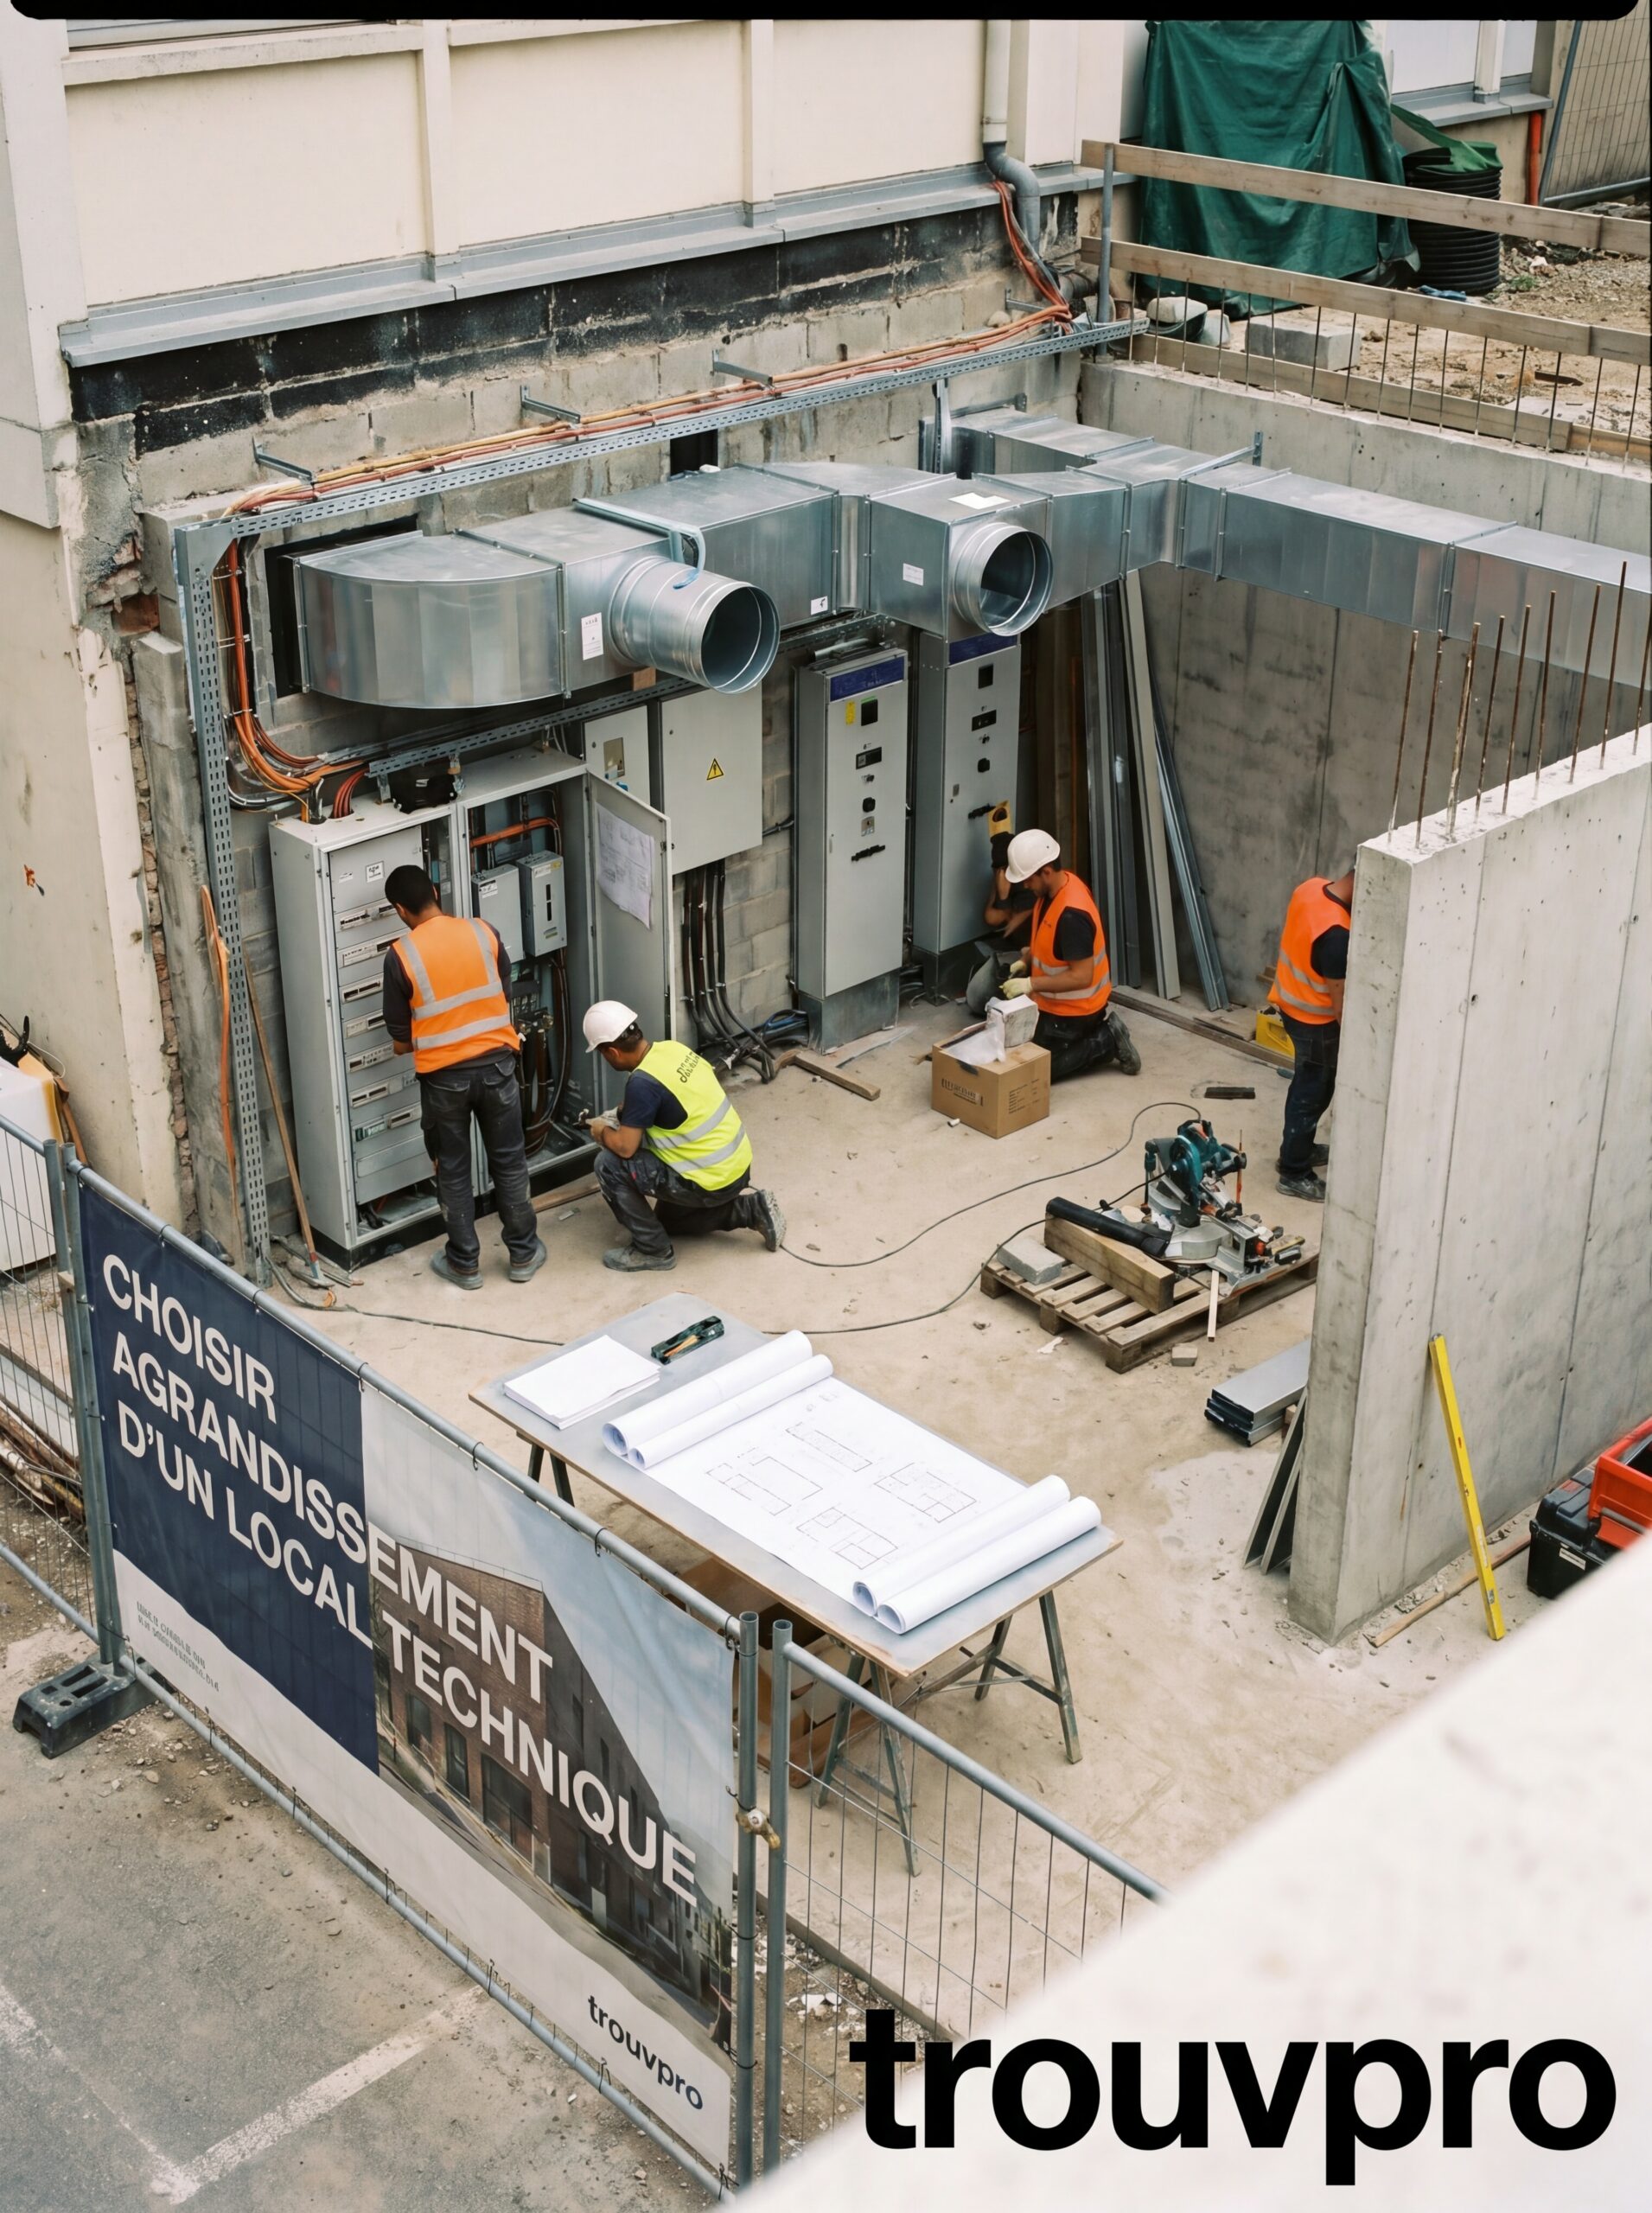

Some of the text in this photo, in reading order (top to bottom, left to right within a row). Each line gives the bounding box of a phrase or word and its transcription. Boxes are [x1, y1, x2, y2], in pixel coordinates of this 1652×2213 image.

[102, 1253, 277, 1425] CHOISIR
[112, 1331, 553, 1705] AGRANDISSEMENT
[118, 1400, 214, 1521] D'UN
[226, 1486, 373, 1650] LOCAL
[381, 1610, 698, 1907] TECHNIQUE
[588, 1995, 703, 2109] trouvpro
